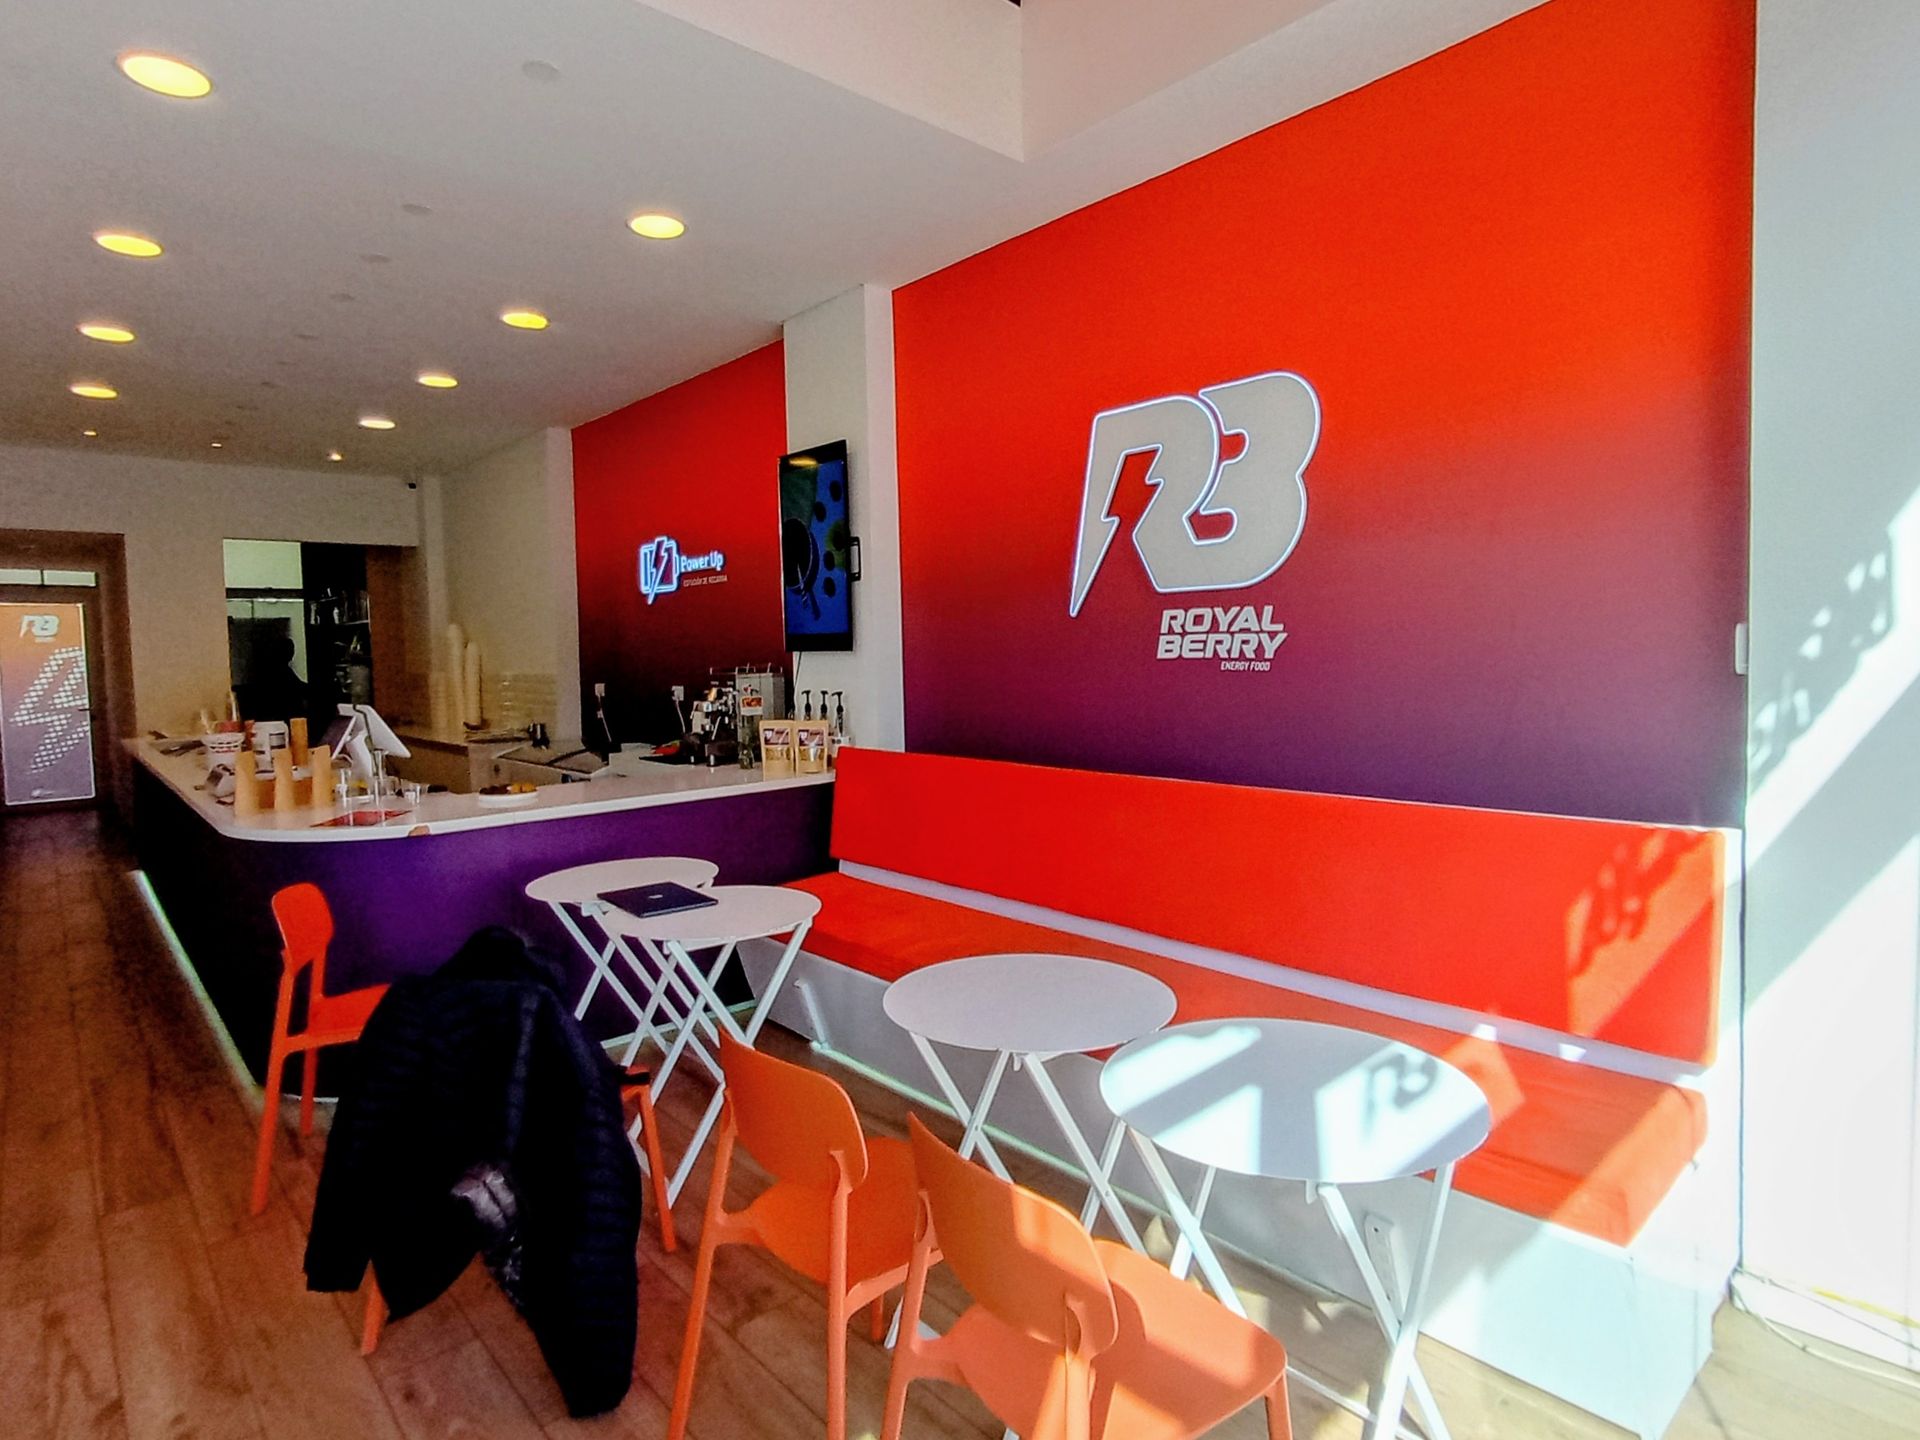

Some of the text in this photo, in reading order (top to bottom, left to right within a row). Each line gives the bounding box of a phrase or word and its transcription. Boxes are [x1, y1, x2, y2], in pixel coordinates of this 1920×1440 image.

[680, 550, 724, 573] Power Up
[1160, 605, 1284, 634] ROYAL
[1156, 632, 1288, 659] BERRY
[1220, 661, 1271, 672] ENERGY FOOD
